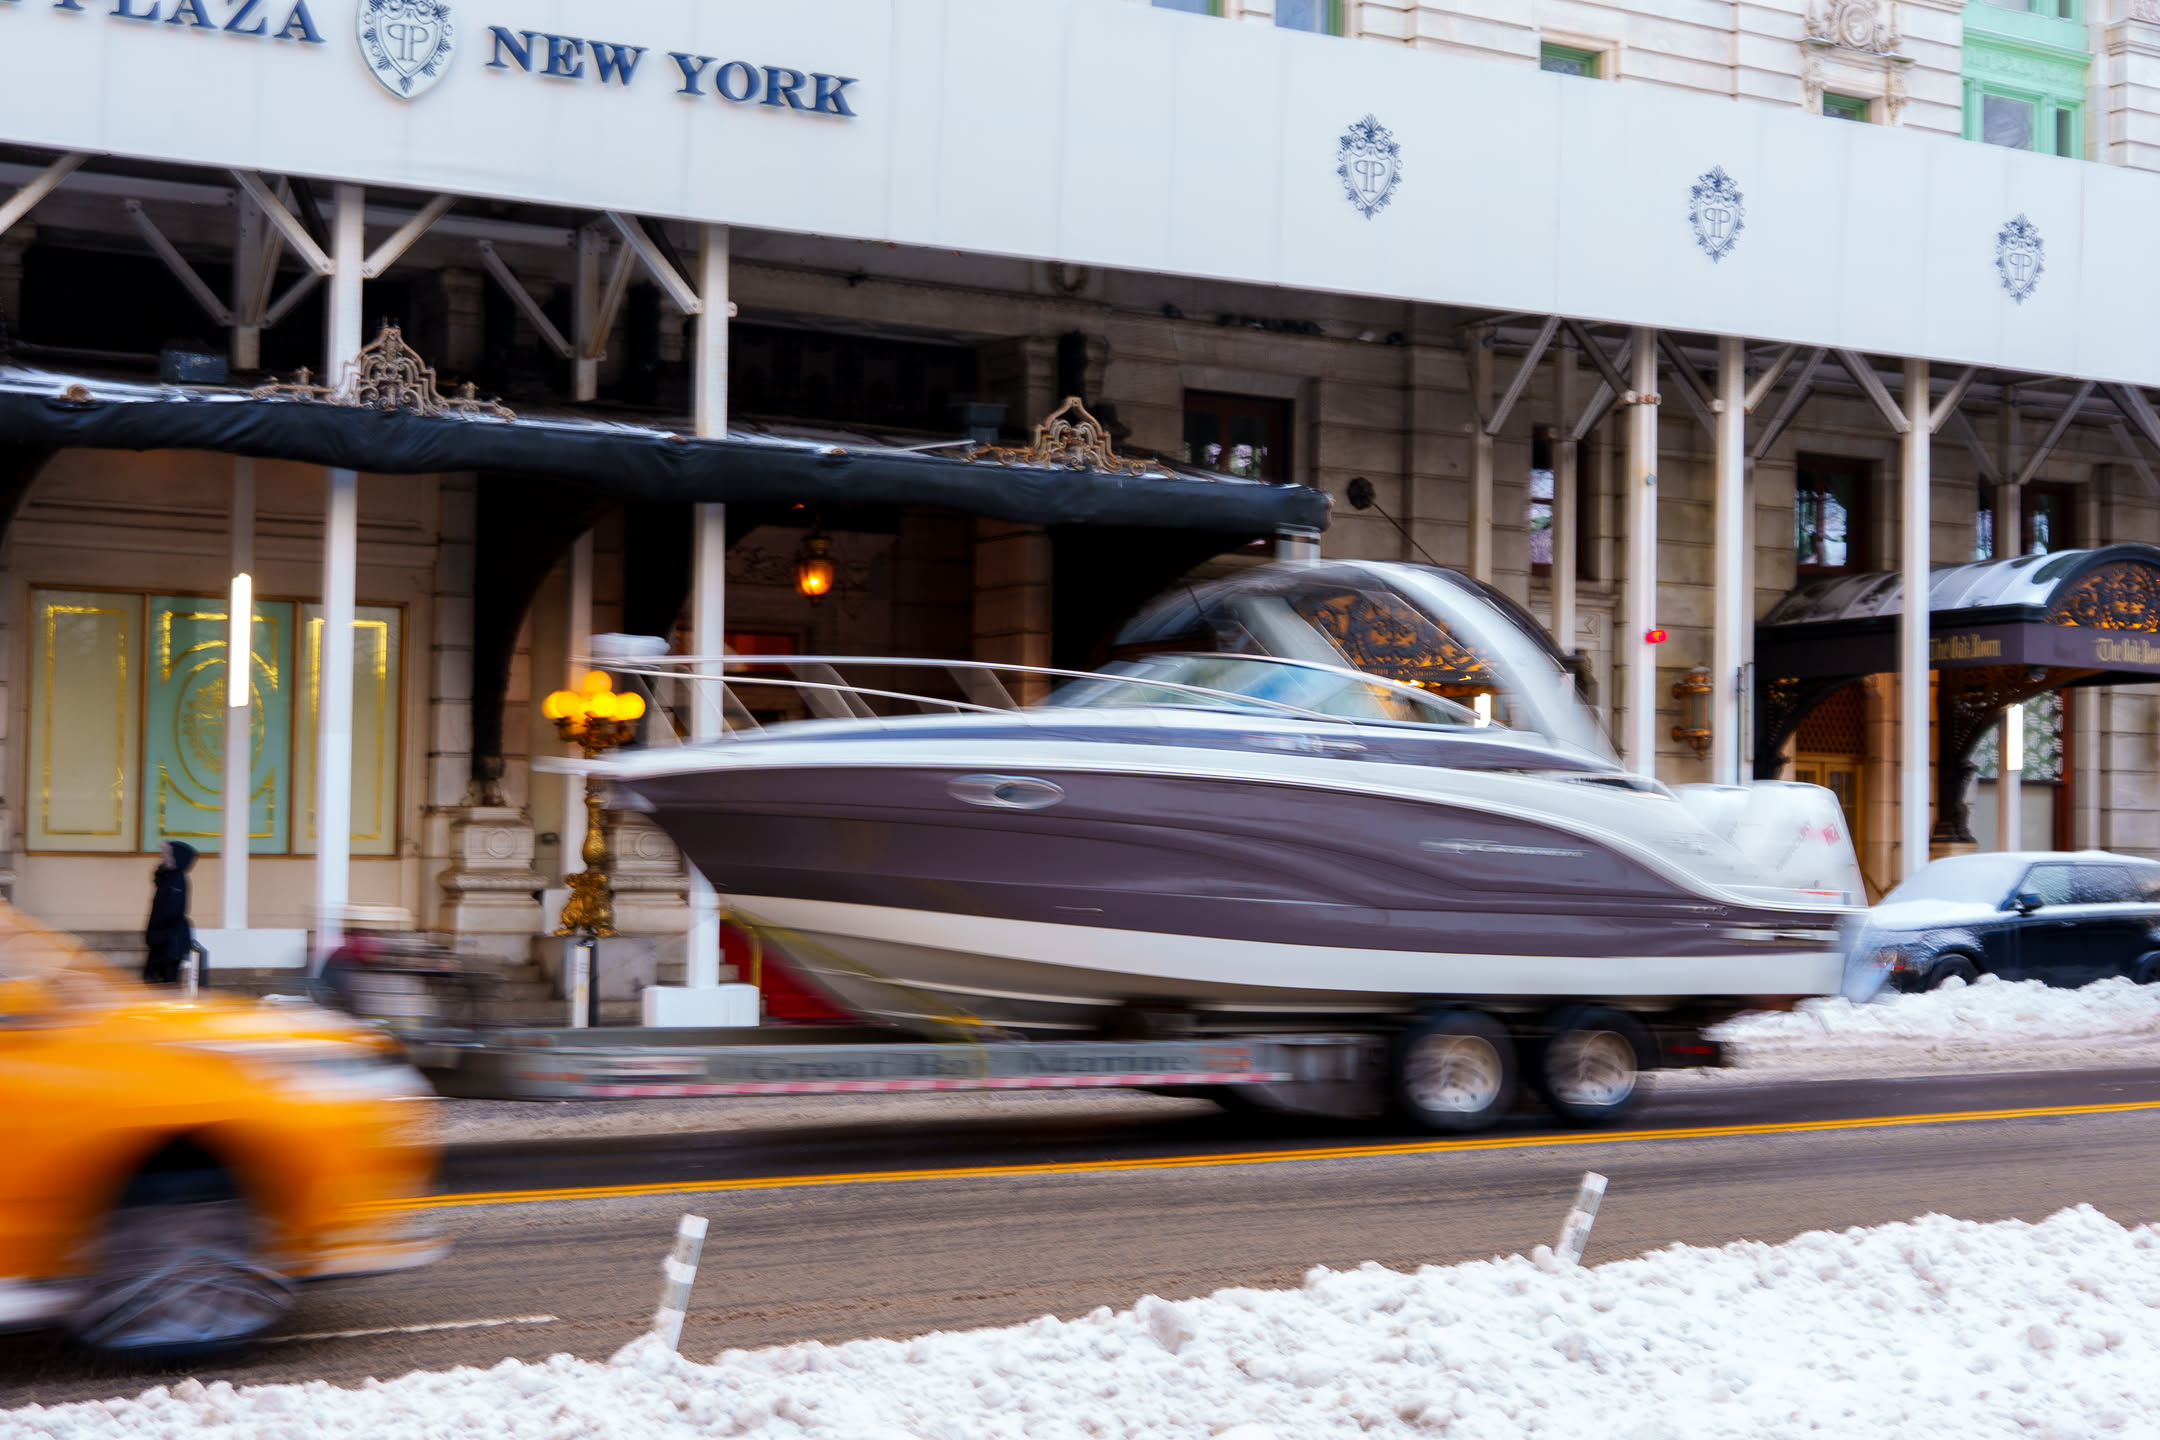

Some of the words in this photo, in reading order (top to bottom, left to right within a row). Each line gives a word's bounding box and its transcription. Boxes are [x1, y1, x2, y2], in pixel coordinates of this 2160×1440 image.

[54, 0, 327, 43] LAZA
[486, 25, 650, 87] NEW
[667, 51, 861, 118] YORK
[2095, 637, 2121, 661] The
